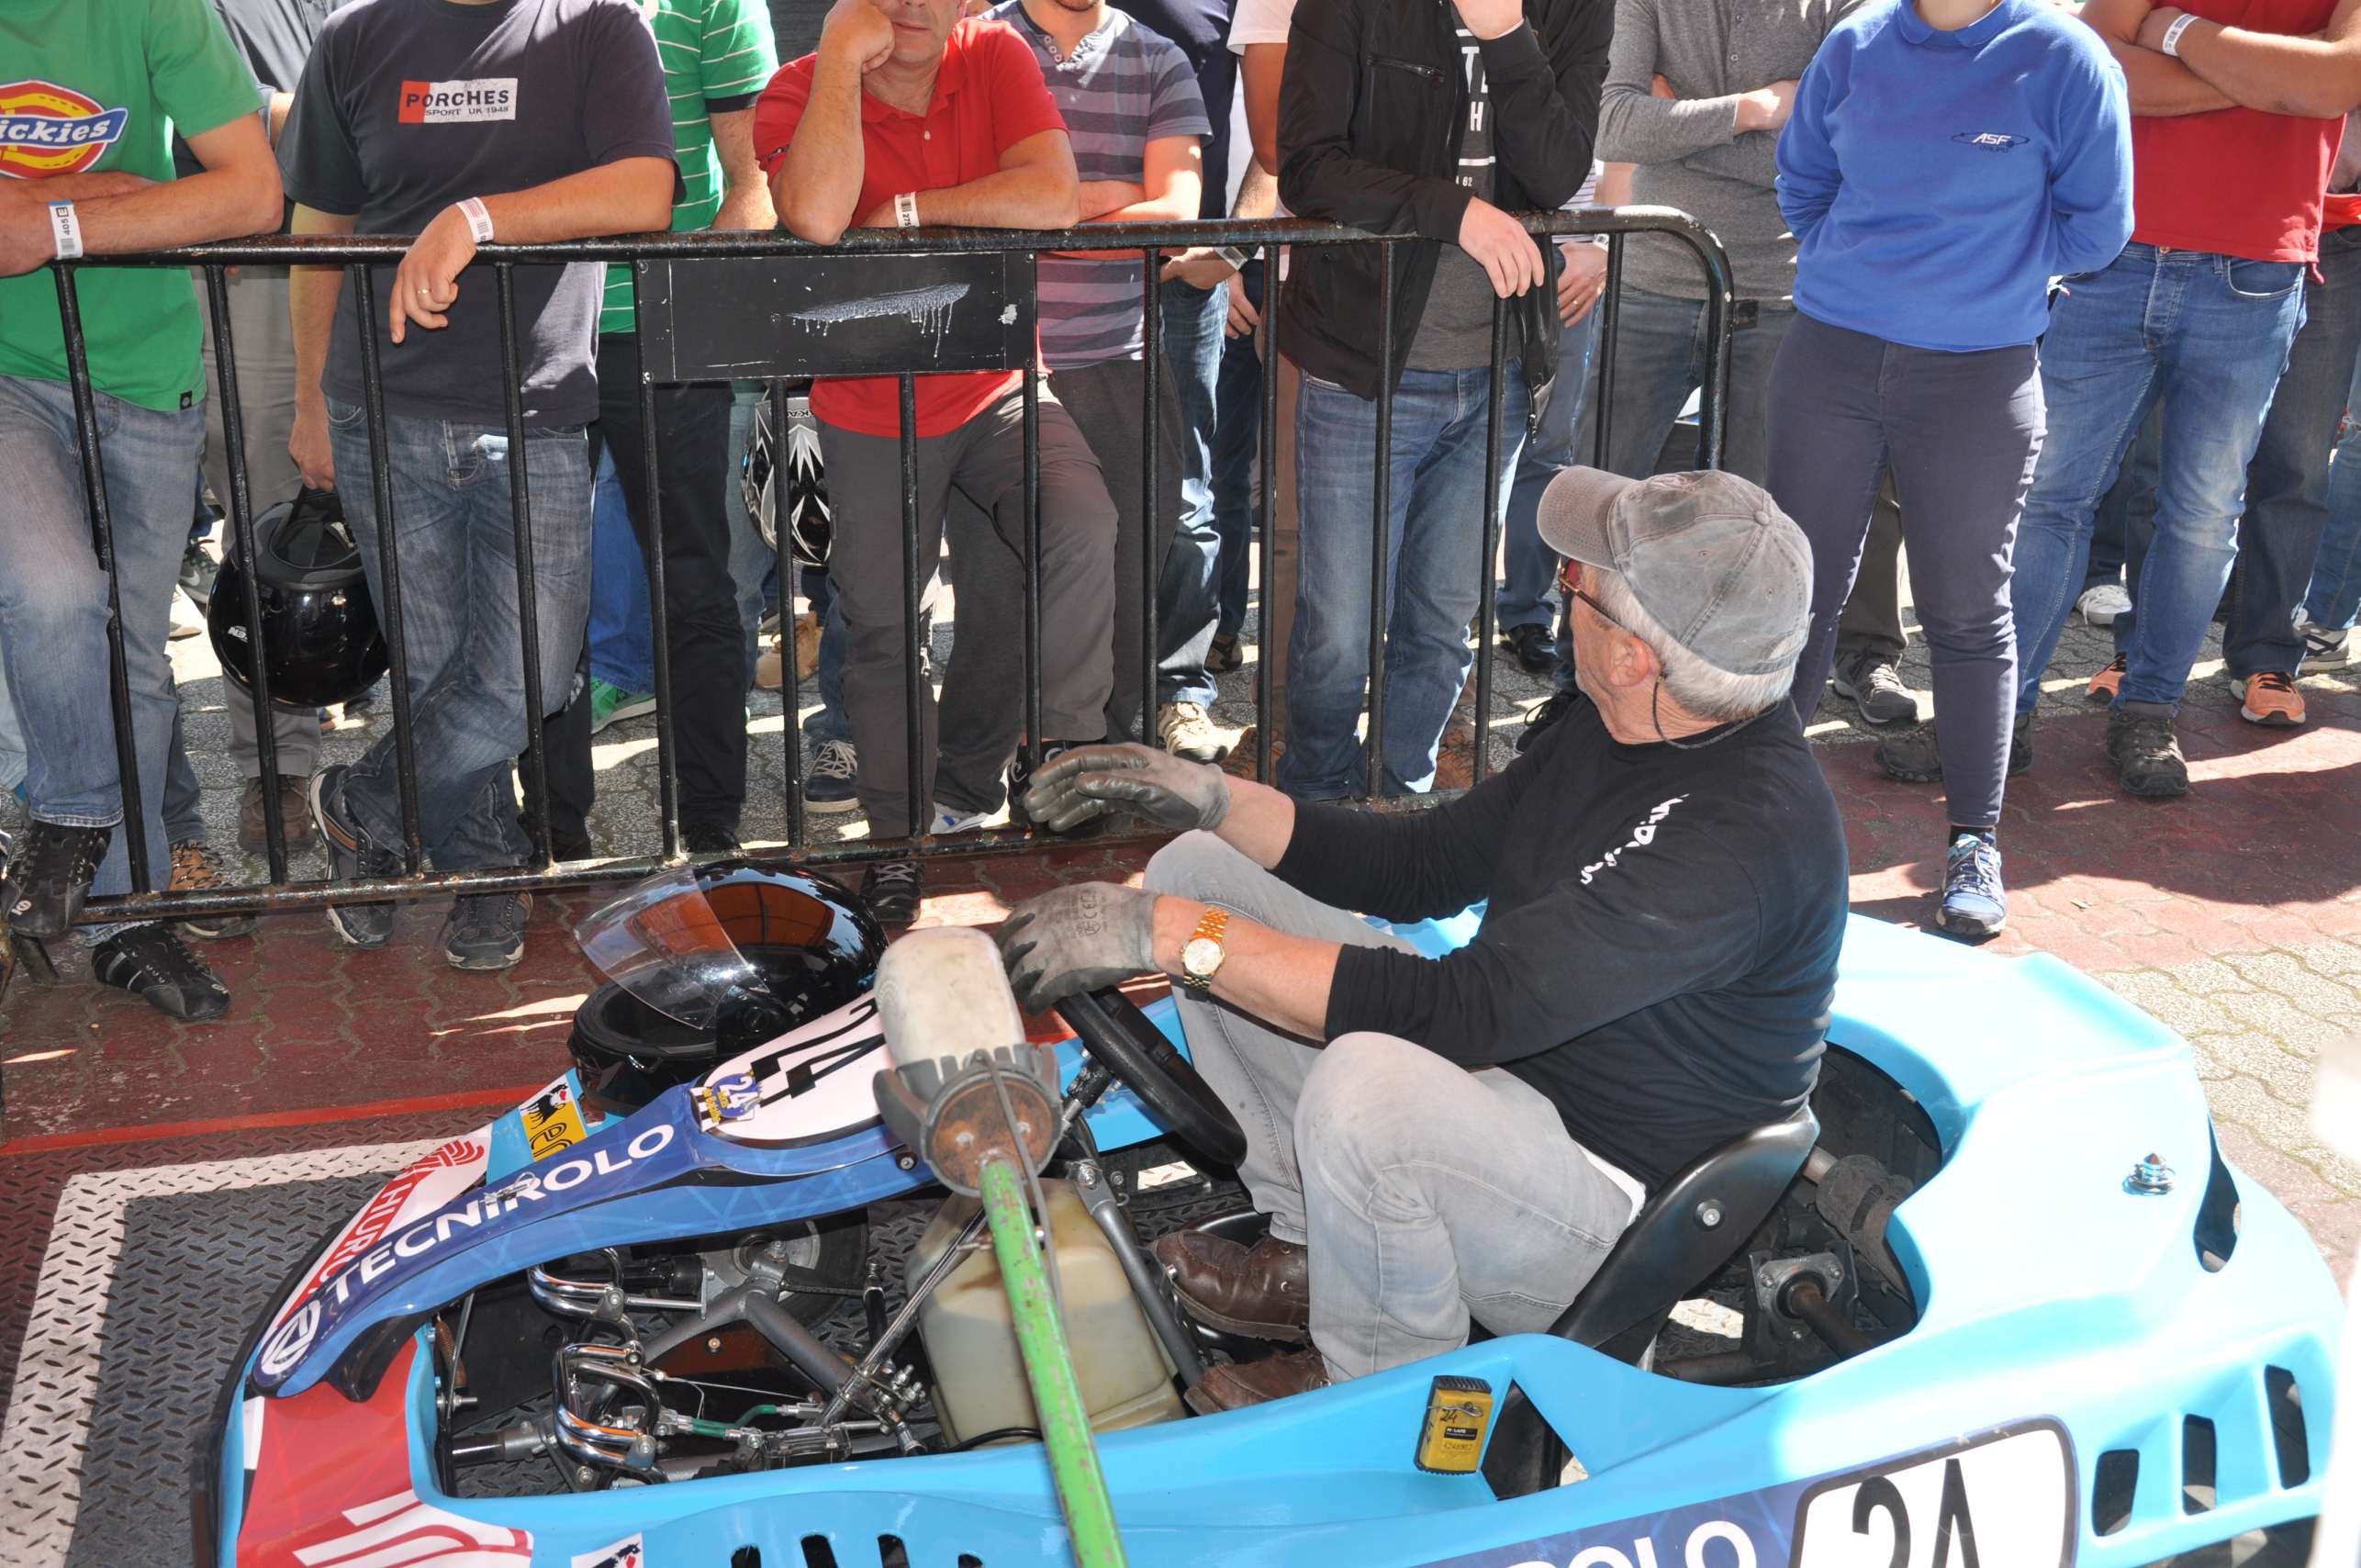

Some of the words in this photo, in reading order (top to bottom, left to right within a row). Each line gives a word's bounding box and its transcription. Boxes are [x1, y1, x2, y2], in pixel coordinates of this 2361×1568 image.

[406, 90, 509, 108] PORCHES
[425, 108, 462, 118] SPORT
[468, 107, 483, 116] UK
[1972, 132, 2012, 145] ASF
[750, 997, 888, 1108] 24
[719, 1075, 760, 1109] 24
[324, 1125, 676, 1305] TECNIROLO
